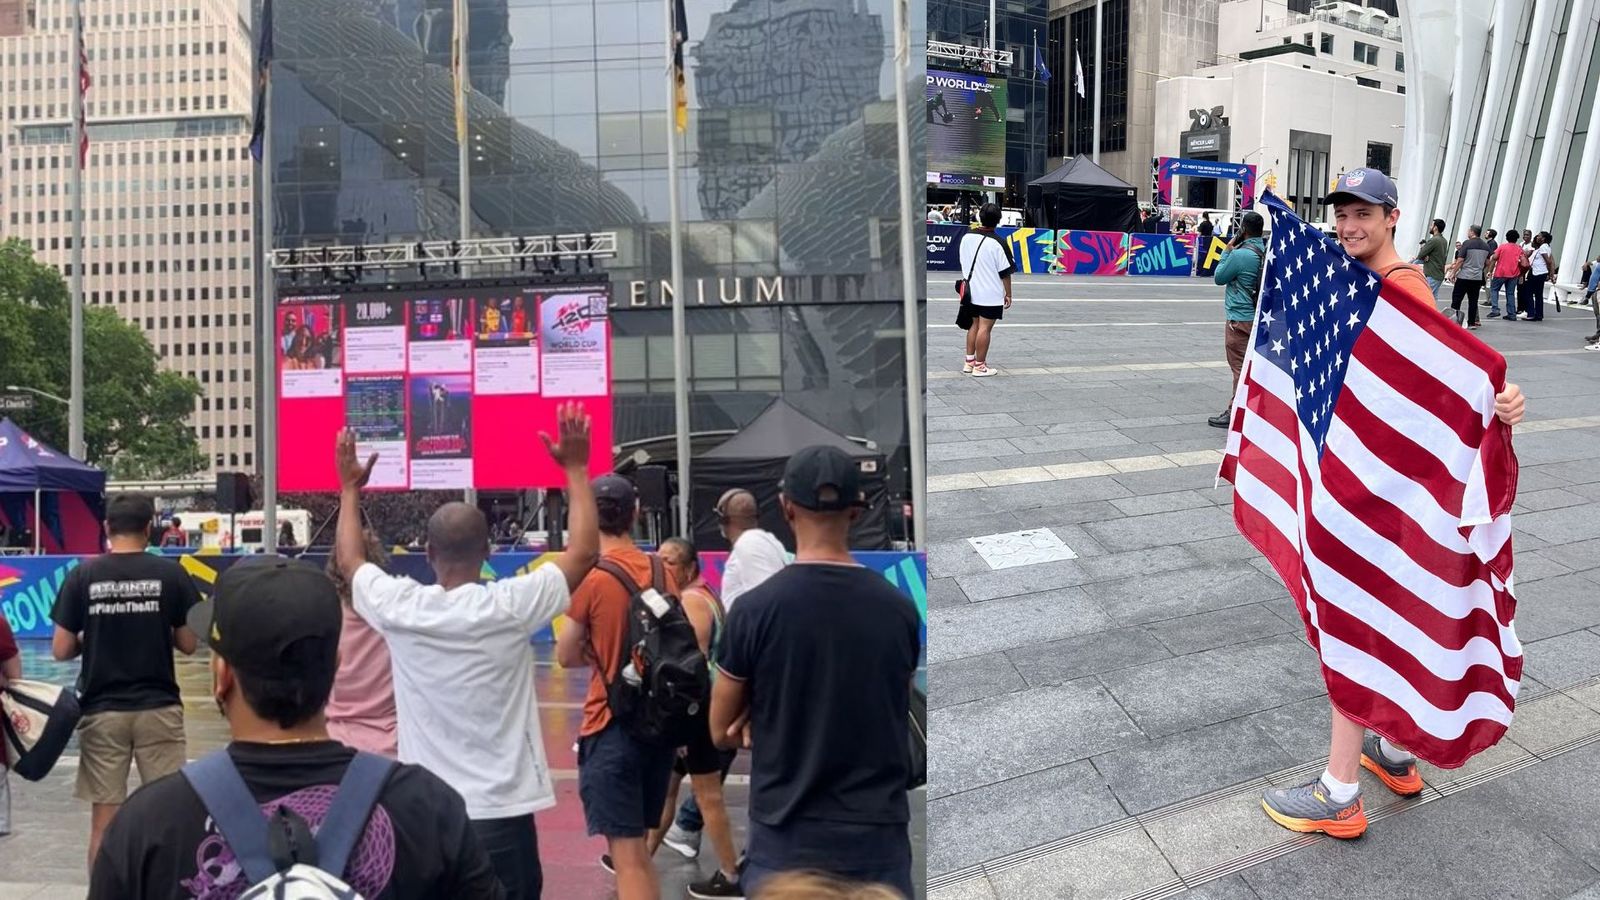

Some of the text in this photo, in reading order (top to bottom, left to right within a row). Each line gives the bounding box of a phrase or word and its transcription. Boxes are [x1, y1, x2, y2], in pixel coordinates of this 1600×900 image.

[936, 77, 980, 91] WORLD
[1069, 231, 1121, 275] SIX
[1135, 236, 1189, 274] BOWL
[609, 276, 785, 307] ENIUM
[2, 558, 80, 634] BOW
[1336, 803, 1360, 821] HOKA
